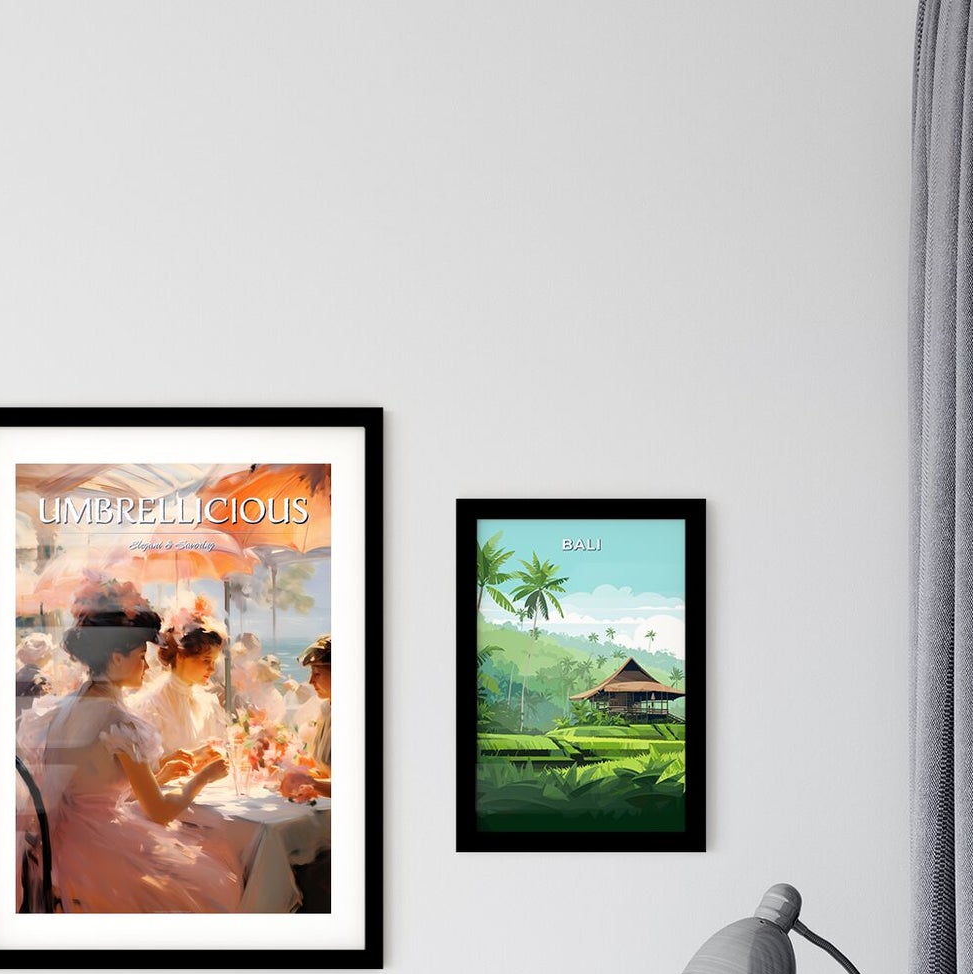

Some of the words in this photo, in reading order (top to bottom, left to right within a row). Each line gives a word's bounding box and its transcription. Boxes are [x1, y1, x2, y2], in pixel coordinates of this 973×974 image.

[38, 497, 309, 525] UMBRELLICIOUS
[129, 540, 163, 552] Elegant
[562, 538, 602, 551] BALI
